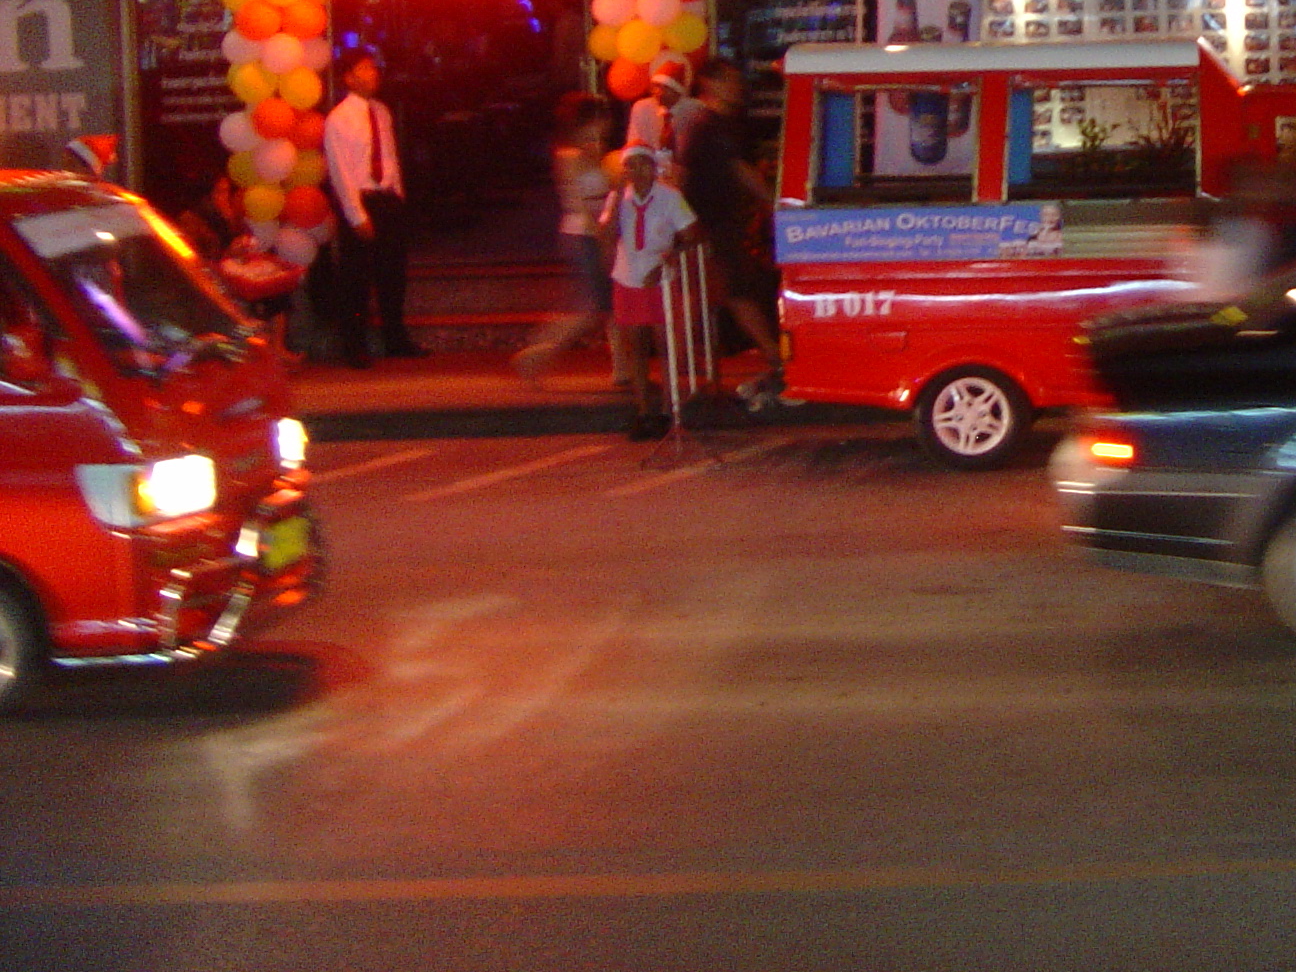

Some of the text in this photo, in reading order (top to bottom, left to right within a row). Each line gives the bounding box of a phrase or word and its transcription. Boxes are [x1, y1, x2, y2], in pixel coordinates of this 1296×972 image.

[0, 92, 86, 132] ENT
[813, 289, 896, 318] B 017
